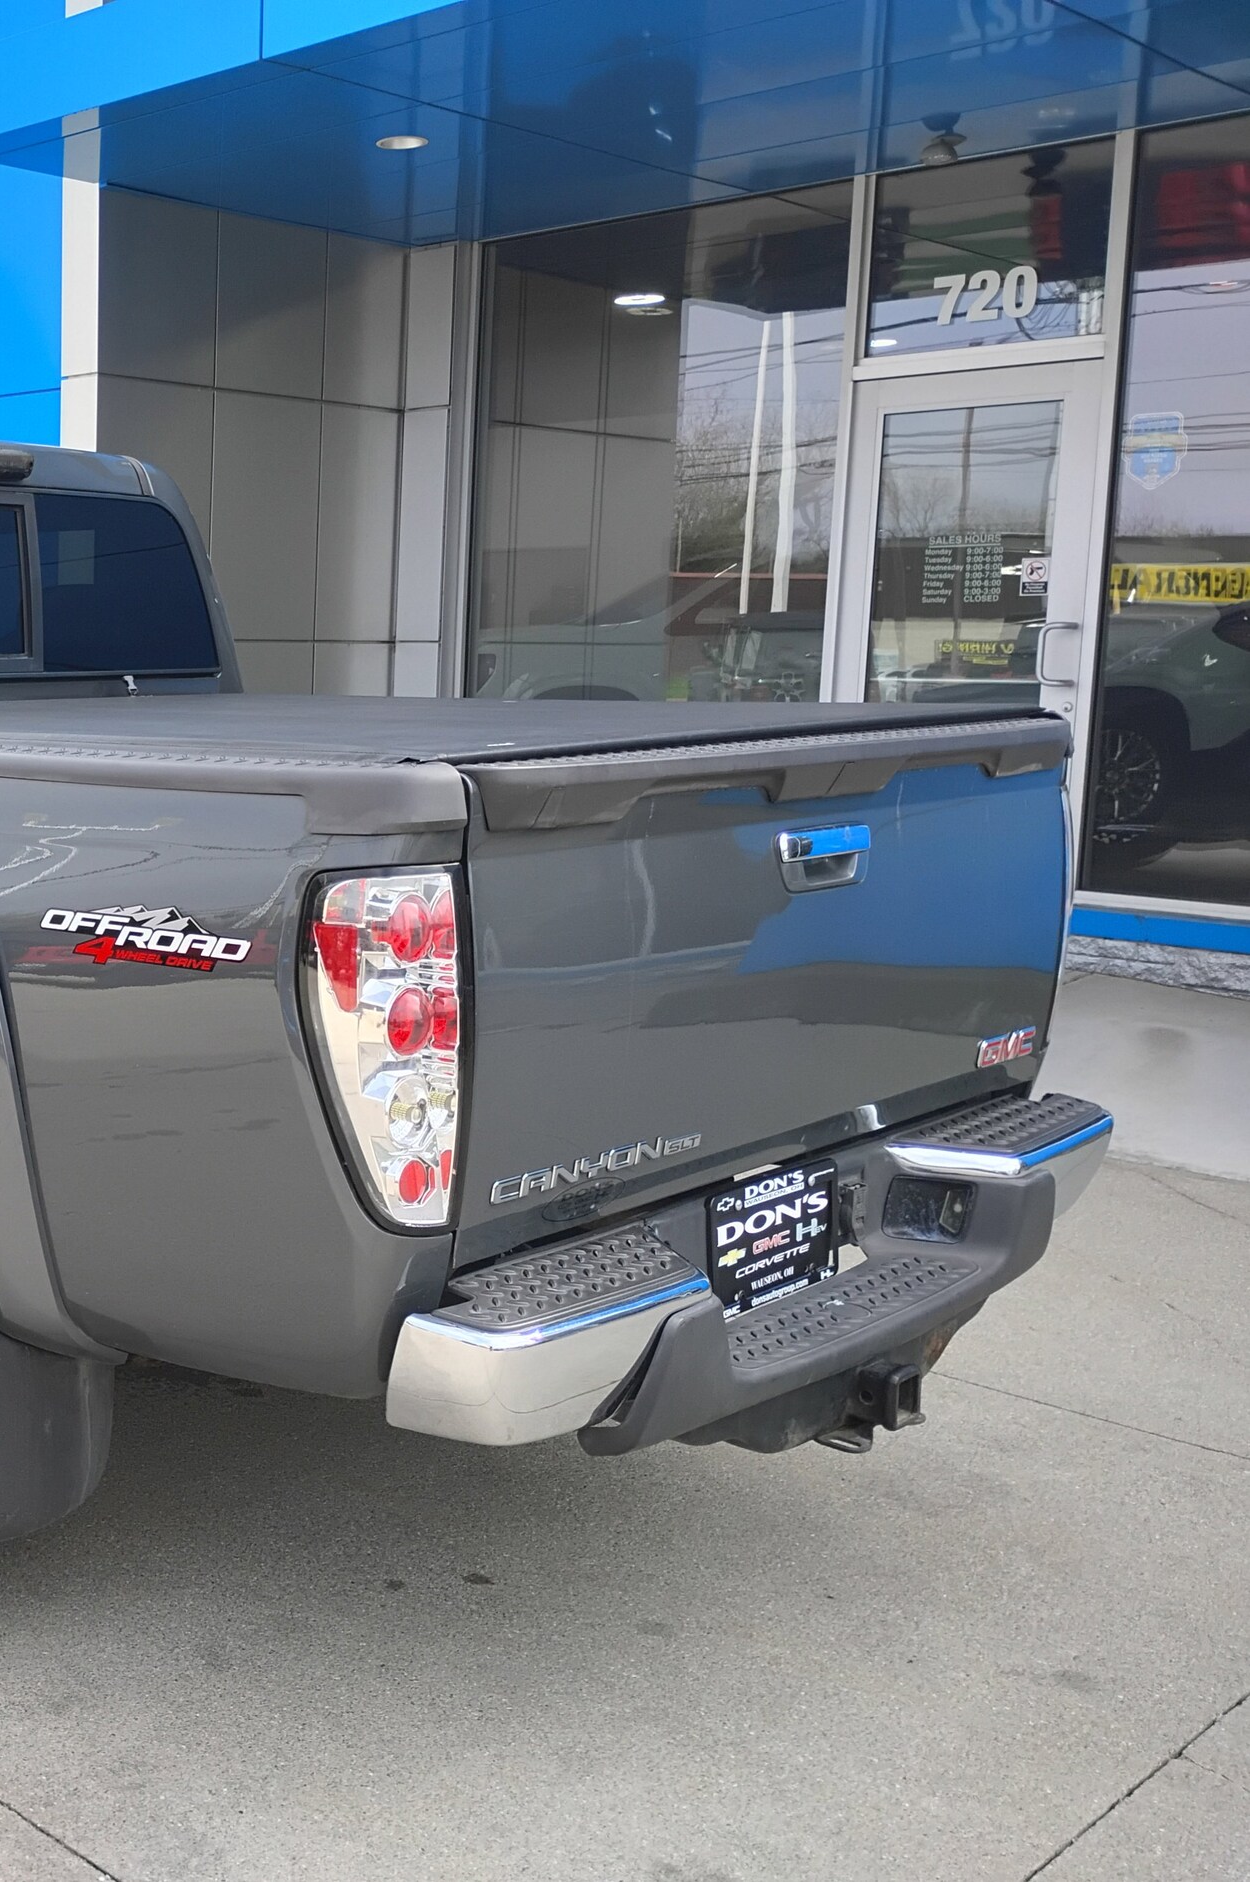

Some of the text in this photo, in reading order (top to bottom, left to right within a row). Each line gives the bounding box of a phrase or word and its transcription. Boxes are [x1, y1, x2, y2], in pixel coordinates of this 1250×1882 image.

[933, 265, 1038, 326] 720
[924, 547, 1004, 557] Monday 9:00-7:00
[929, 533, 1002, 545] SALES HOURS
[924, 564, 964, 572] Wednesday
[924, 571, 1002, 580] Thursday 9:00-7:00
[922, 588, 952, 596] Saturday
[923, 580, 944, 588] Friday
[921, 595, 999, 604] Sunday CLOSED
[73, 936, 214, 972] 4 WHEEL DRIVE
[975, 1026, 1037, 1068] GMC
[490, 1136, 663, 1205] CANYON
[663, 1133, 702, 1156] SLT
[745, 1169, 805, 1200] DON'S
[716, 1190, 830, 1248] DON'S
[752, 1229, 791, 1255] GMC
[735, 1243, 810, 1279] CORVETTE
[723, 1305, 741, 1319] GMC
[751, 1278, 809, 1307] donsautogroup.com
